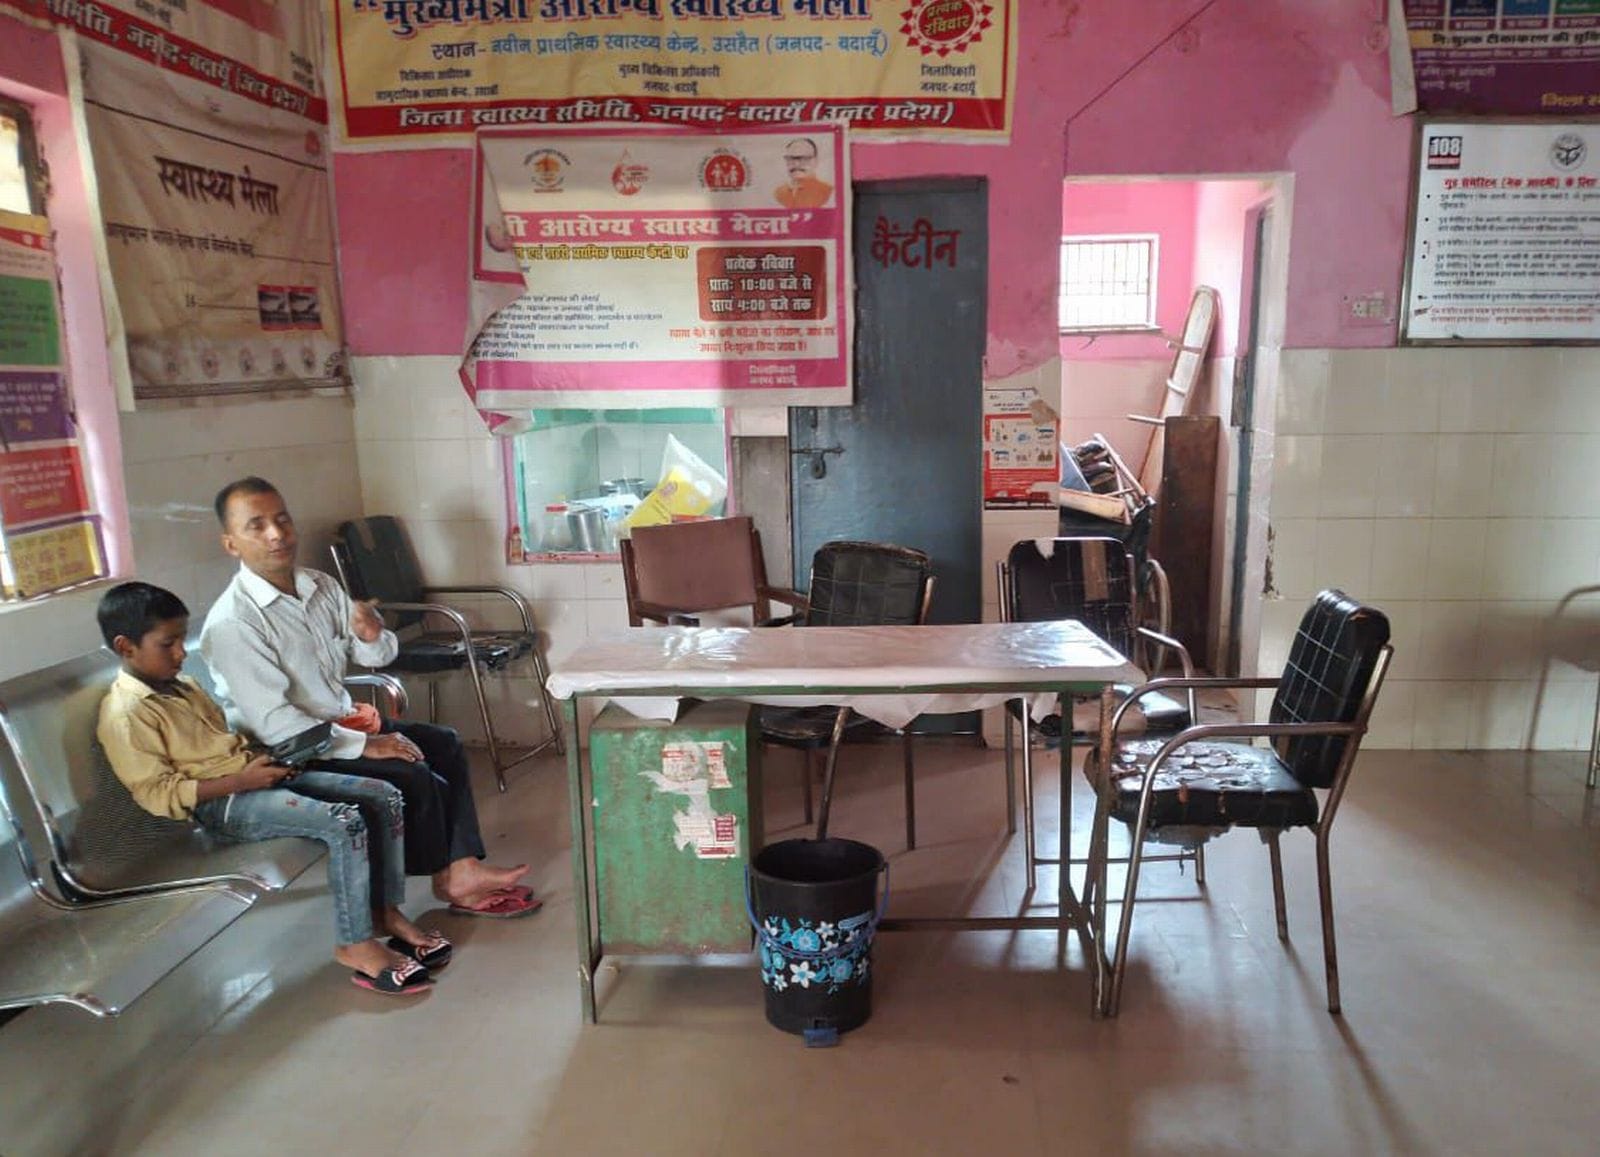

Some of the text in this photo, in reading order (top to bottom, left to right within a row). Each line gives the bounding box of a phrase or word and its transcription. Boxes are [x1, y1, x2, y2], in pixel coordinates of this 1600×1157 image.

[924, 16, 970, 36] रविवार
[491, 34, 531, 54] नवीन
[537, 32, 599, 55] प्राथमिक
[605, 34, 661, 53] स्वास्थ्य
[400, 108, 464, 126] जिला
[472, 107, 549, 124] स्वास्थ्य
[555, 100, 641, 121] समिति,
[649, 100, 804, 122] जनपद-बदायँ
[882, 102, 955, 123] प्रदेश)
[1429, 138, 1460, 156] 108
[154, 155, 279, 216] स्वास्थ्य मेला
[539, 215, 635, 237] आरोग्य
[761, 254, 795, 271] रविवार
[740, 278, 774, 290] 10:00
[737, 298, 765, 312] 4:00
[793, 298, 811, 311] तक
